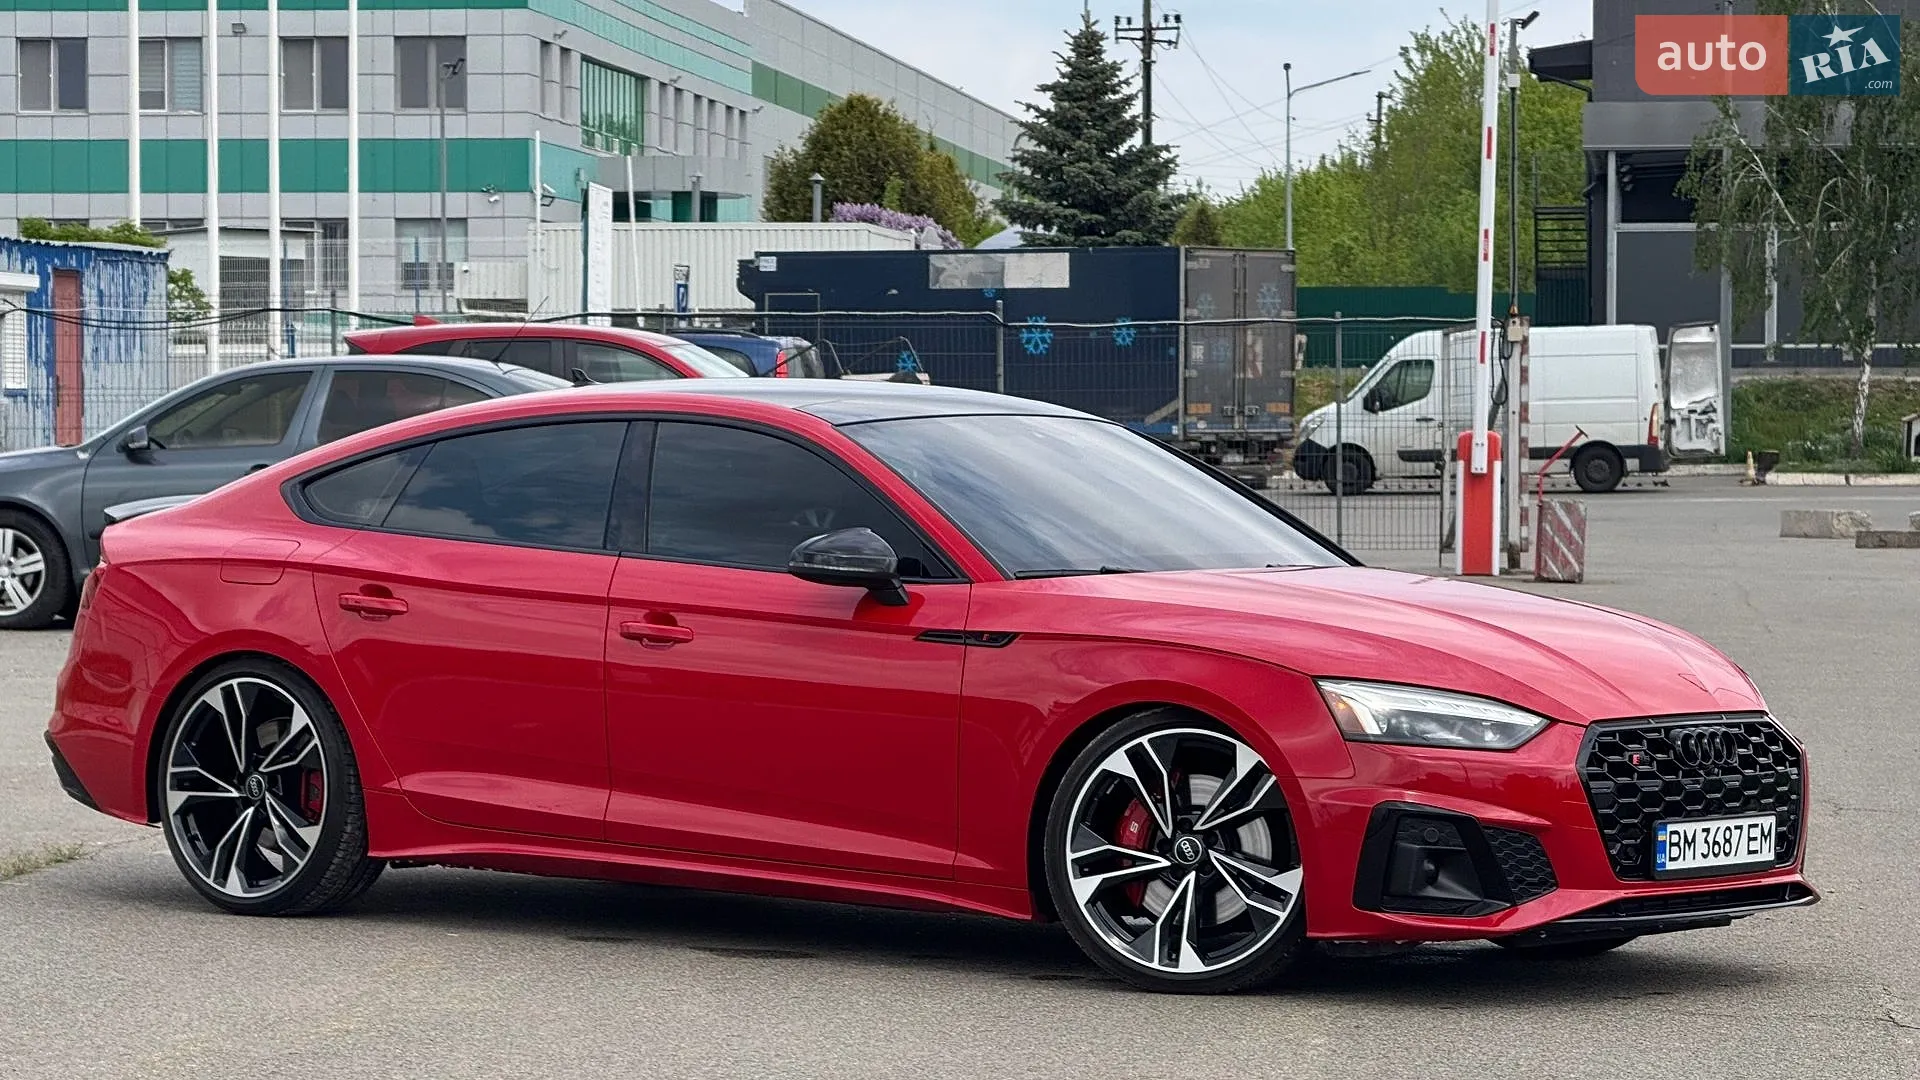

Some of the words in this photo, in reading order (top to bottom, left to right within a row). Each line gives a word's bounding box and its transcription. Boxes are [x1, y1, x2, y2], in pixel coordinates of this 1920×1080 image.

[1668, 828, 1697, 862] BM
[1700, 824, 1744, 859] 3687
[1746, 821, 1773, 855] EM
